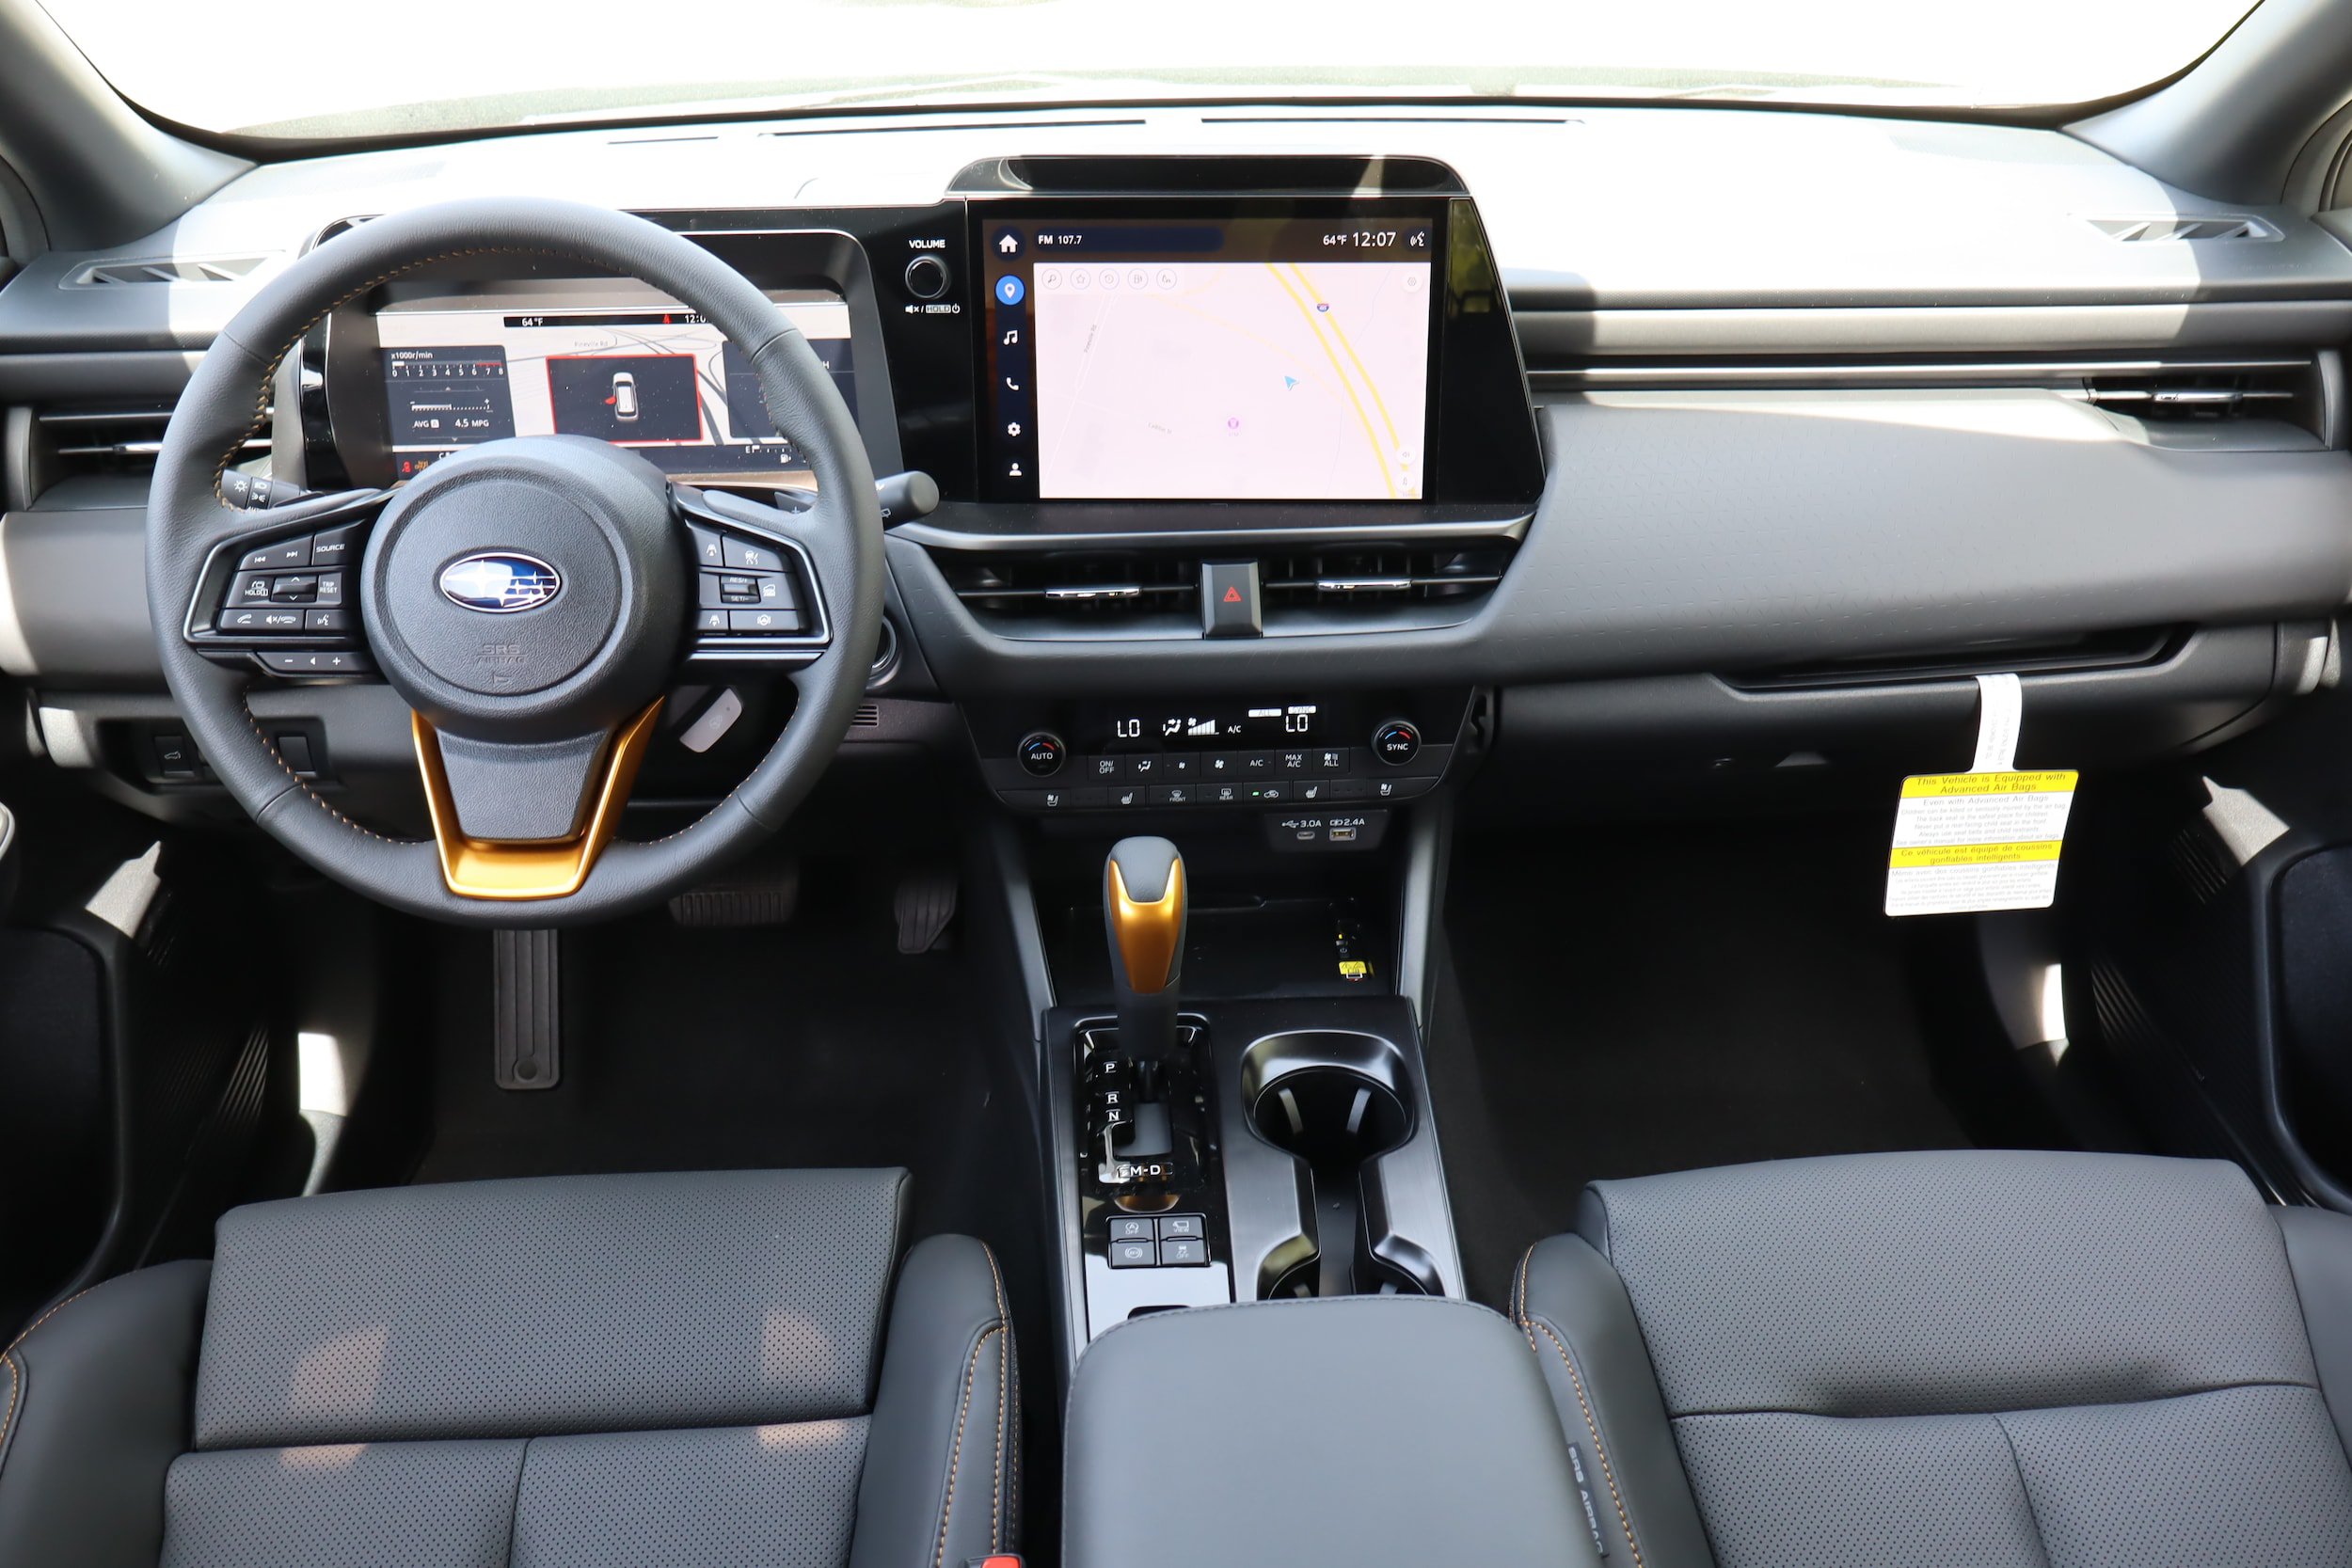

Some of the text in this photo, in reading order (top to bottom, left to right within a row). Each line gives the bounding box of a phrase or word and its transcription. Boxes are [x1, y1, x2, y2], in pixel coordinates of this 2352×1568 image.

[1038, 234, 1082, 245] FM 107.7
[1323, 234, 1347, 245] 64°F
[1353, 231, 1396, 246] 12:07
[909, 239, 946, 249] VOLUME
[927, 305, 951, 313] HOLD
[684, 314, 707, 324] 12:0
[414, 420, 429, 428] AVG
[454, 419, 490, 428] 4.5 MPG
[745, 445, 752, 453] E
[316, 543, 345, 553] SOURCE
[245, 589, 261, 597] HOLD
[482, 643, 520, 655] SRS
[1117, 719, 1141, 737] LO
[1285, 714, 1309, 733] LO
[1227, 725, 1242, 736] A/C
[1387, 742, 1408, 752] SYNC
[1030, 752, 1053, 760] AUTO
[1249, 759, 1263, 768] A/C
[1286, 760, 1302, 768] A/C
[1099, 767, 1116, 775] OFF
[1917, 772, 2066, 786] This Vehicle is Equipped with
[1940, 782, 2037, 795] Advanced Air Bags
[1948, 798, 1964, 806] with
[1967, 796, 2010, 805] Advanced
[2011, 795, 2024, 803] Air
[2026, 794, 2048, 803] Bags
[1300, 819, 1322, 829] 3.0A
[1343, 817, 1366, 827] 2.4A
[2002, 844, 2012, 852] de
[1105, 1063, 1116, 1073] P
[1107, 1093, 1119, 1103] R
[1108, 1111, 1120, 1121] N
[1568, 1446, 1585, 1483] SRS
